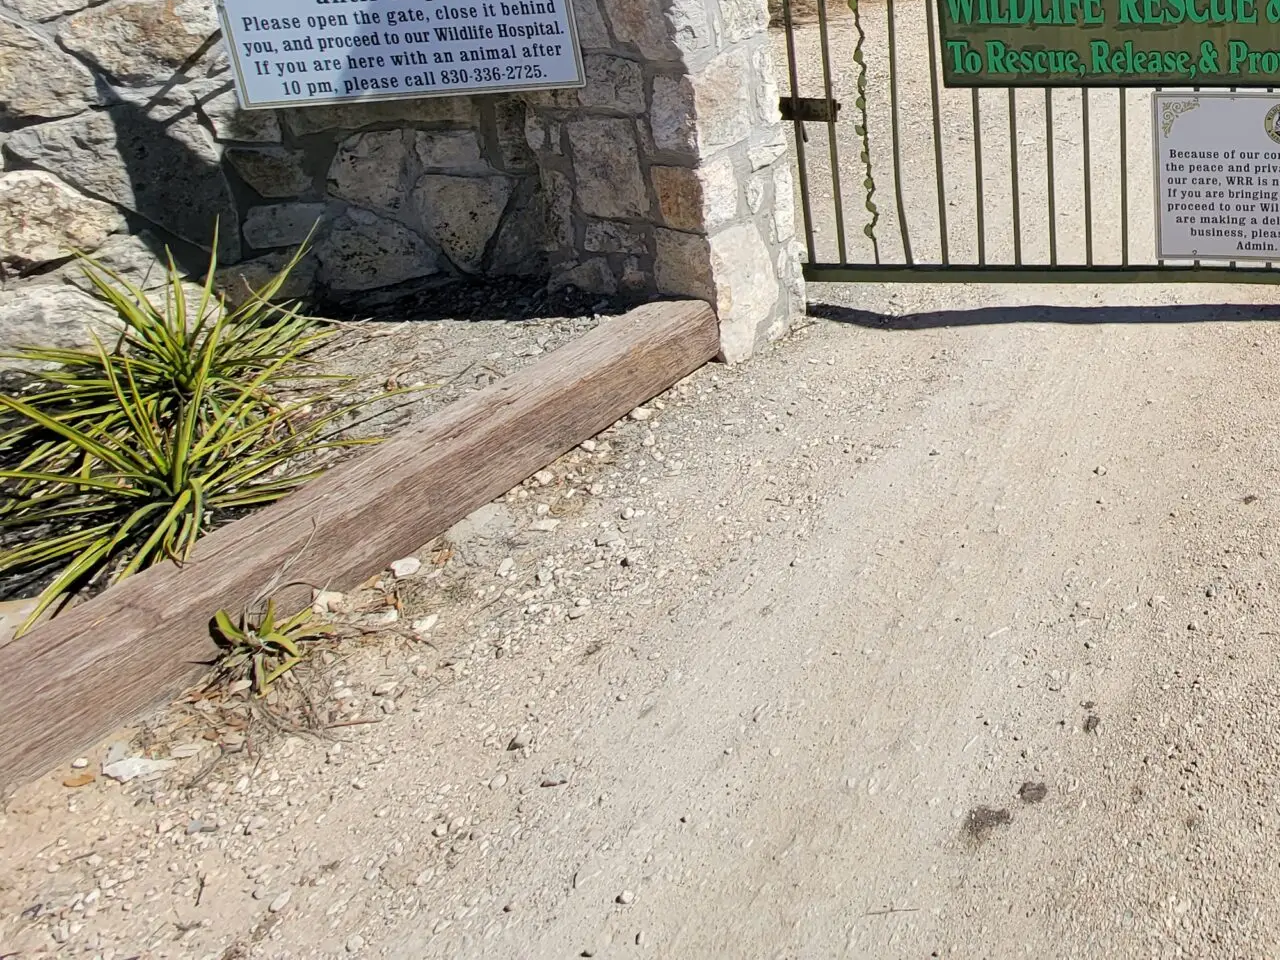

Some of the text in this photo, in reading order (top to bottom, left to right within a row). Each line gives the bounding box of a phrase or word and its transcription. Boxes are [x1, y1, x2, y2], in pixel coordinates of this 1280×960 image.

[241, 0, 556, 32] Please open the gate, close it behind
[243, 20, 565, 57] you, and proceed to our Wildlife Hospital.
[254, 42, 562, 77] If you are here with an animal after
[947, 40, 982, 74] To
[986, 40, 1086, 77] Rescue,
[1091, 41, 1197, 79] Release,
[1200, 40, 1220, 73] &
[282, 64, 548, 96] 10 pm, please call 830-336-2725.
[1169, 149, 1219, 159] Because
[1223, 149, 1236, 159] of
[1240, 151, 1260, 160] our
[1166, 162, 1185, 172] the
[1189, 163, 1224, 173] peace
[1228, 163, 1250, 173] and
[1167, 176, 1187, 185] our
[1191, 176, 1222, 186] care,
[1226, 175, 1254, 186] WRR
[1257, 176, 1268, 186] is
[1167, 188, 1177, 198] If
[1181, 189, 1201, 200] you
[1205, 189, 1225, 199] are
[1228, 189, 1278, 201] bringing
[1167, 202, 1215, 212] proceed
[1219, 203, 1231, 212] to
[1235, 203, 1256, 212] our
[1175, 215, 1196, 224] are
[1200, 215, 1247, 226] making
[1250, 216, 1258, 225] a
[1190, 227, 1247, 239] business,
[1236, 241, 1278, 252] Admin.
